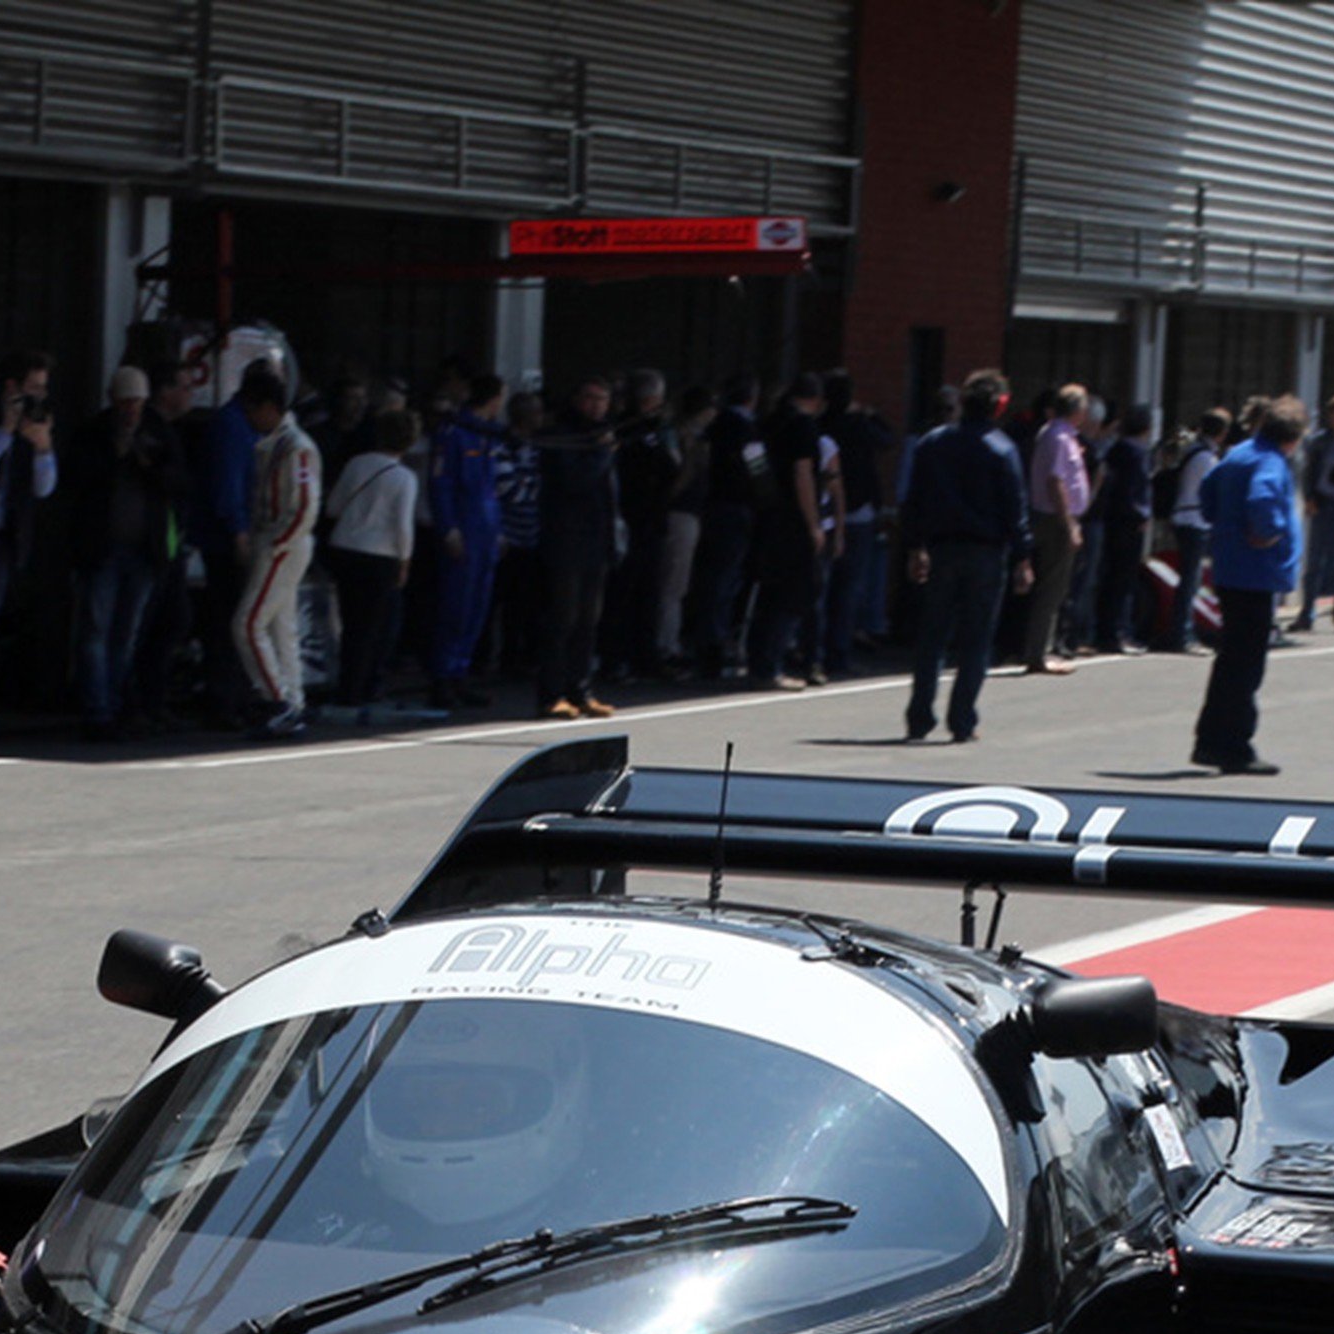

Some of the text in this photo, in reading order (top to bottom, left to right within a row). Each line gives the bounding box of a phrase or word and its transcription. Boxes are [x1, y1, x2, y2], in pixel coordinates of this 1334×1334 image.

[427, 922, 713, 989] Alpha
[410, 984, 680, 1011] RACING TEAM
